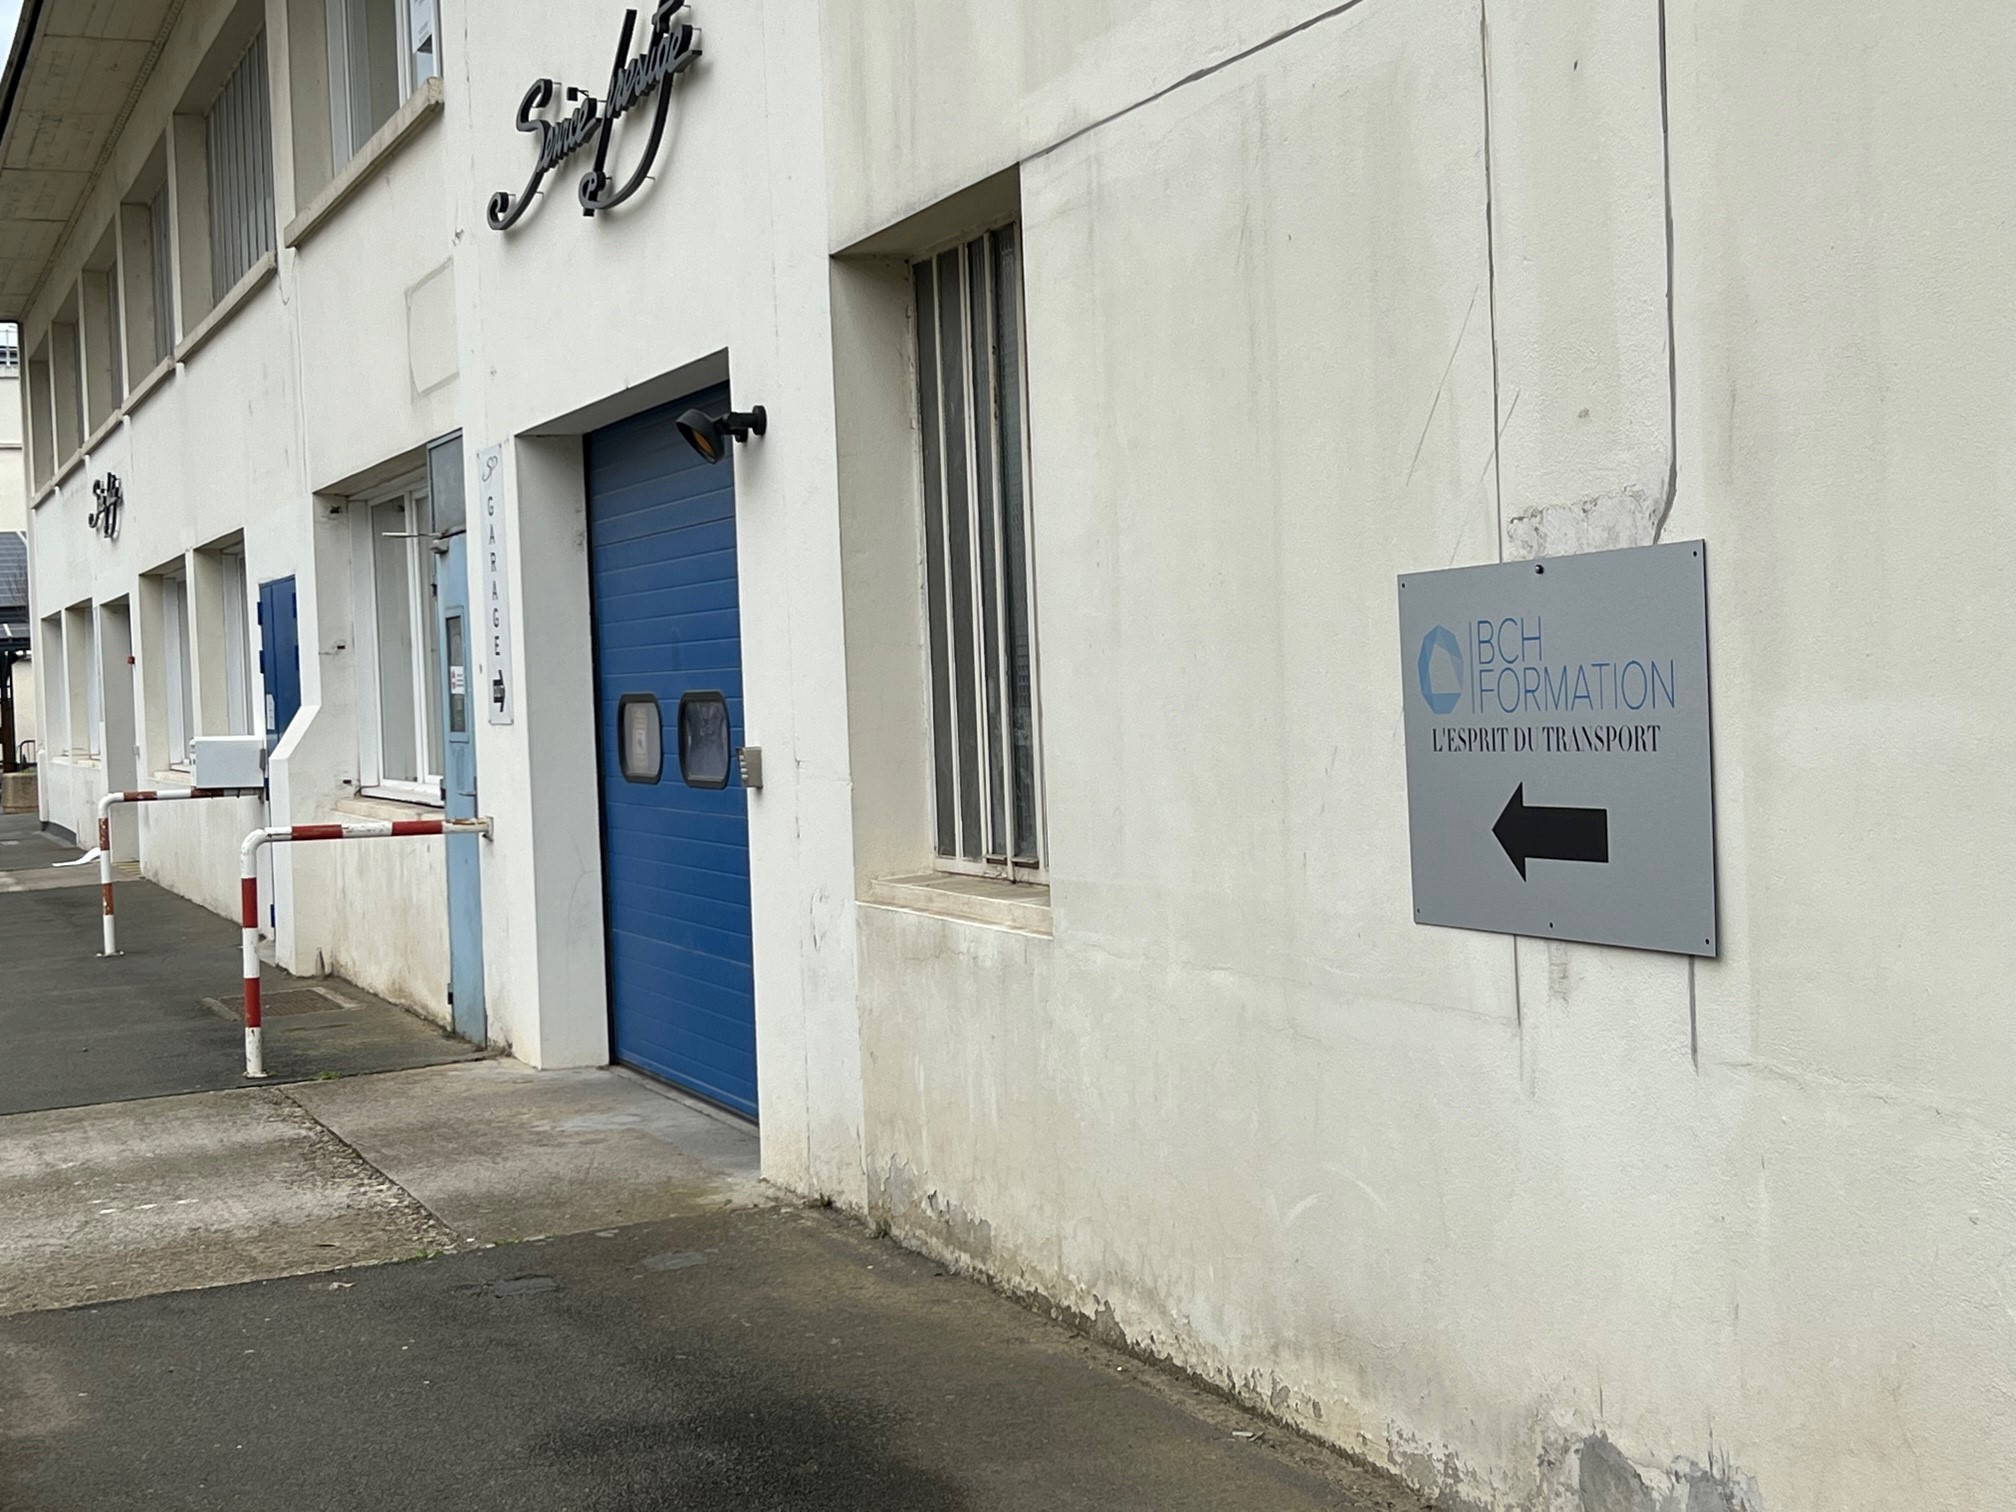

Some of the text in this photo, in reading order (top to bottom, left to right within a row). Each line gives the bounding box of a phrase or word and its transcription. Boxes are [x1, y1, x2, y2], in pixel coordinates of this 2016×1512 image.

[487, 496, 500, 656] GARAGE
[1476, 616, 1542, 664] BCH
[1478, 659, 1676, 714] FORMATION
[1431, 725, 1661, 752] L'ESPRIT DU TRANSPORT
